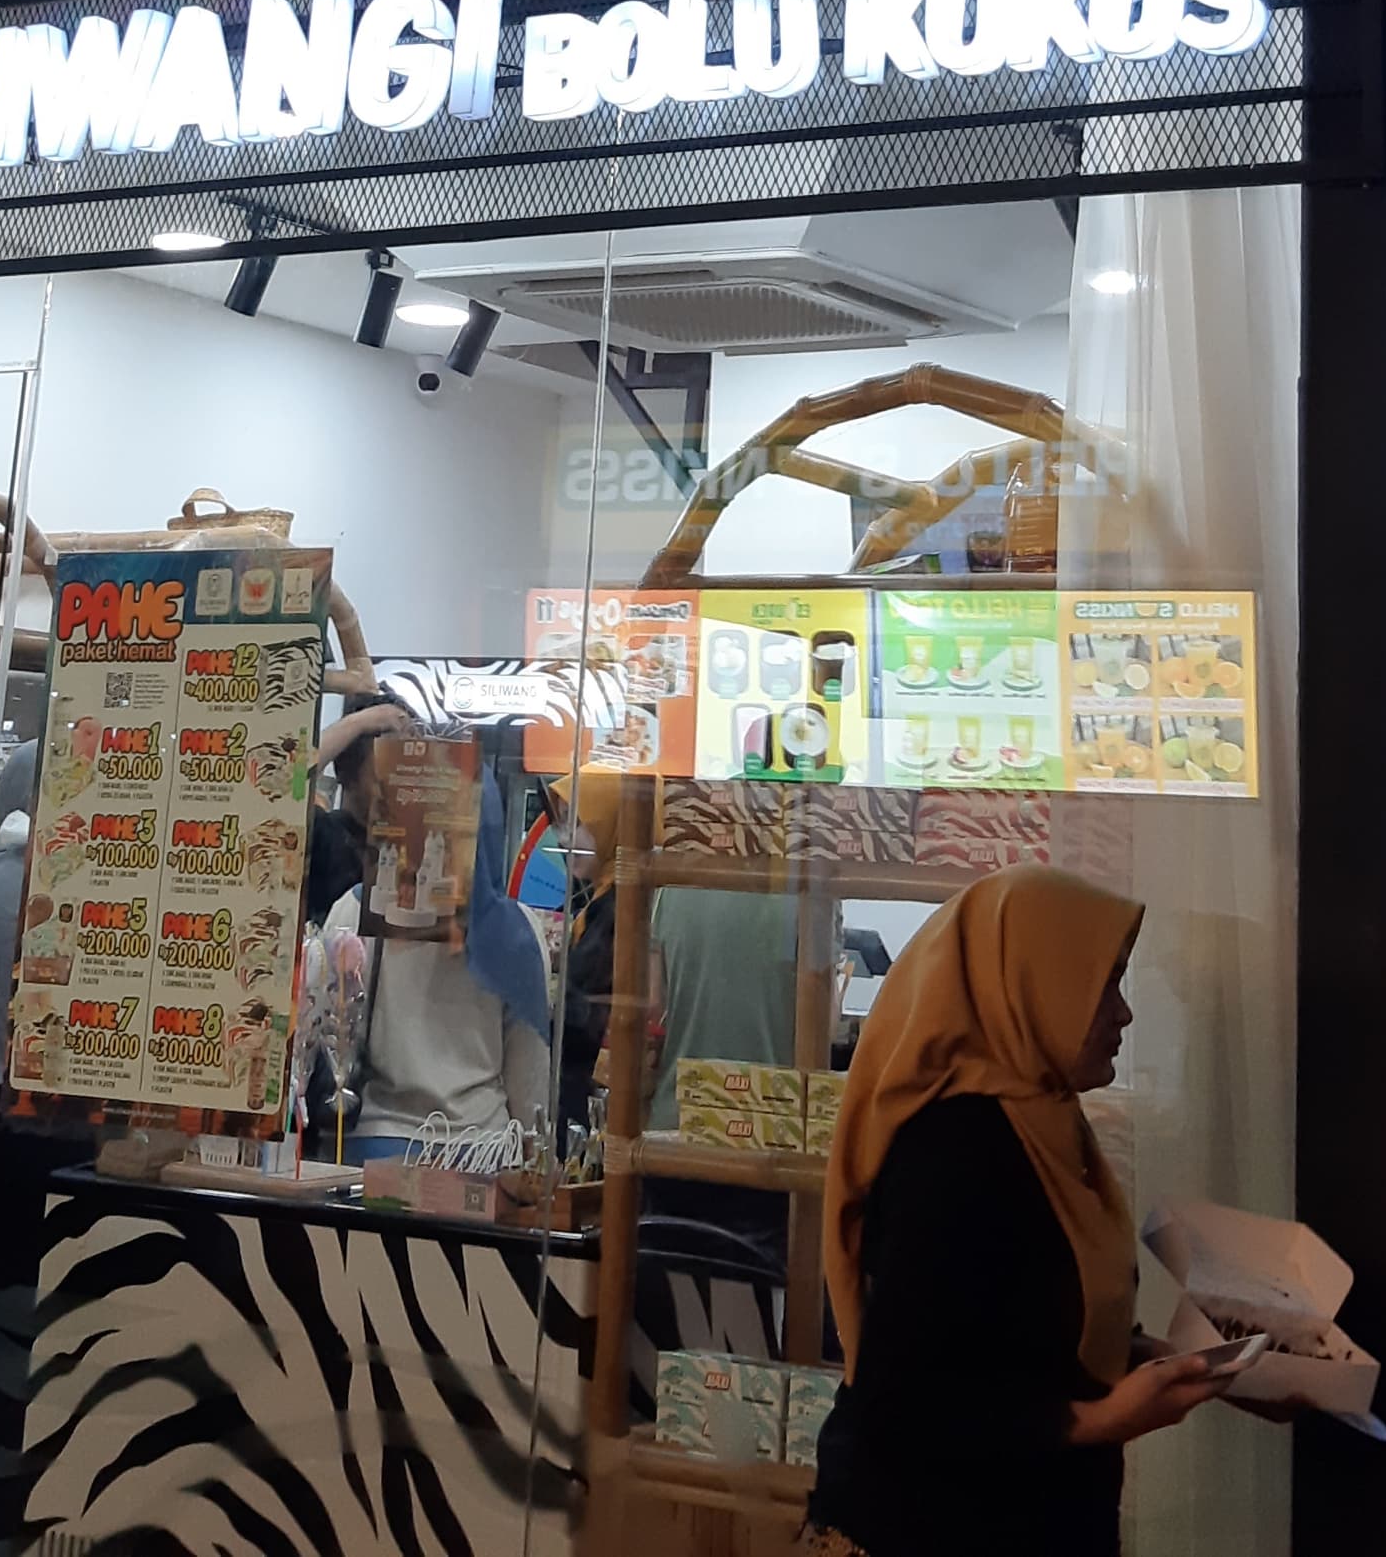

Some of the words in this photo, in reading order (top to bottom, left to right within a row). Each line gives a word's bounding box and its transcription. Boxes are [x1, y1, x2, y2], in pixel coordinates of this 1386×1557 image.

[56, 580, 185, 641] PAHE
[60, 641, 114, 668] paket
[115, 639, 177, 663] hemat
